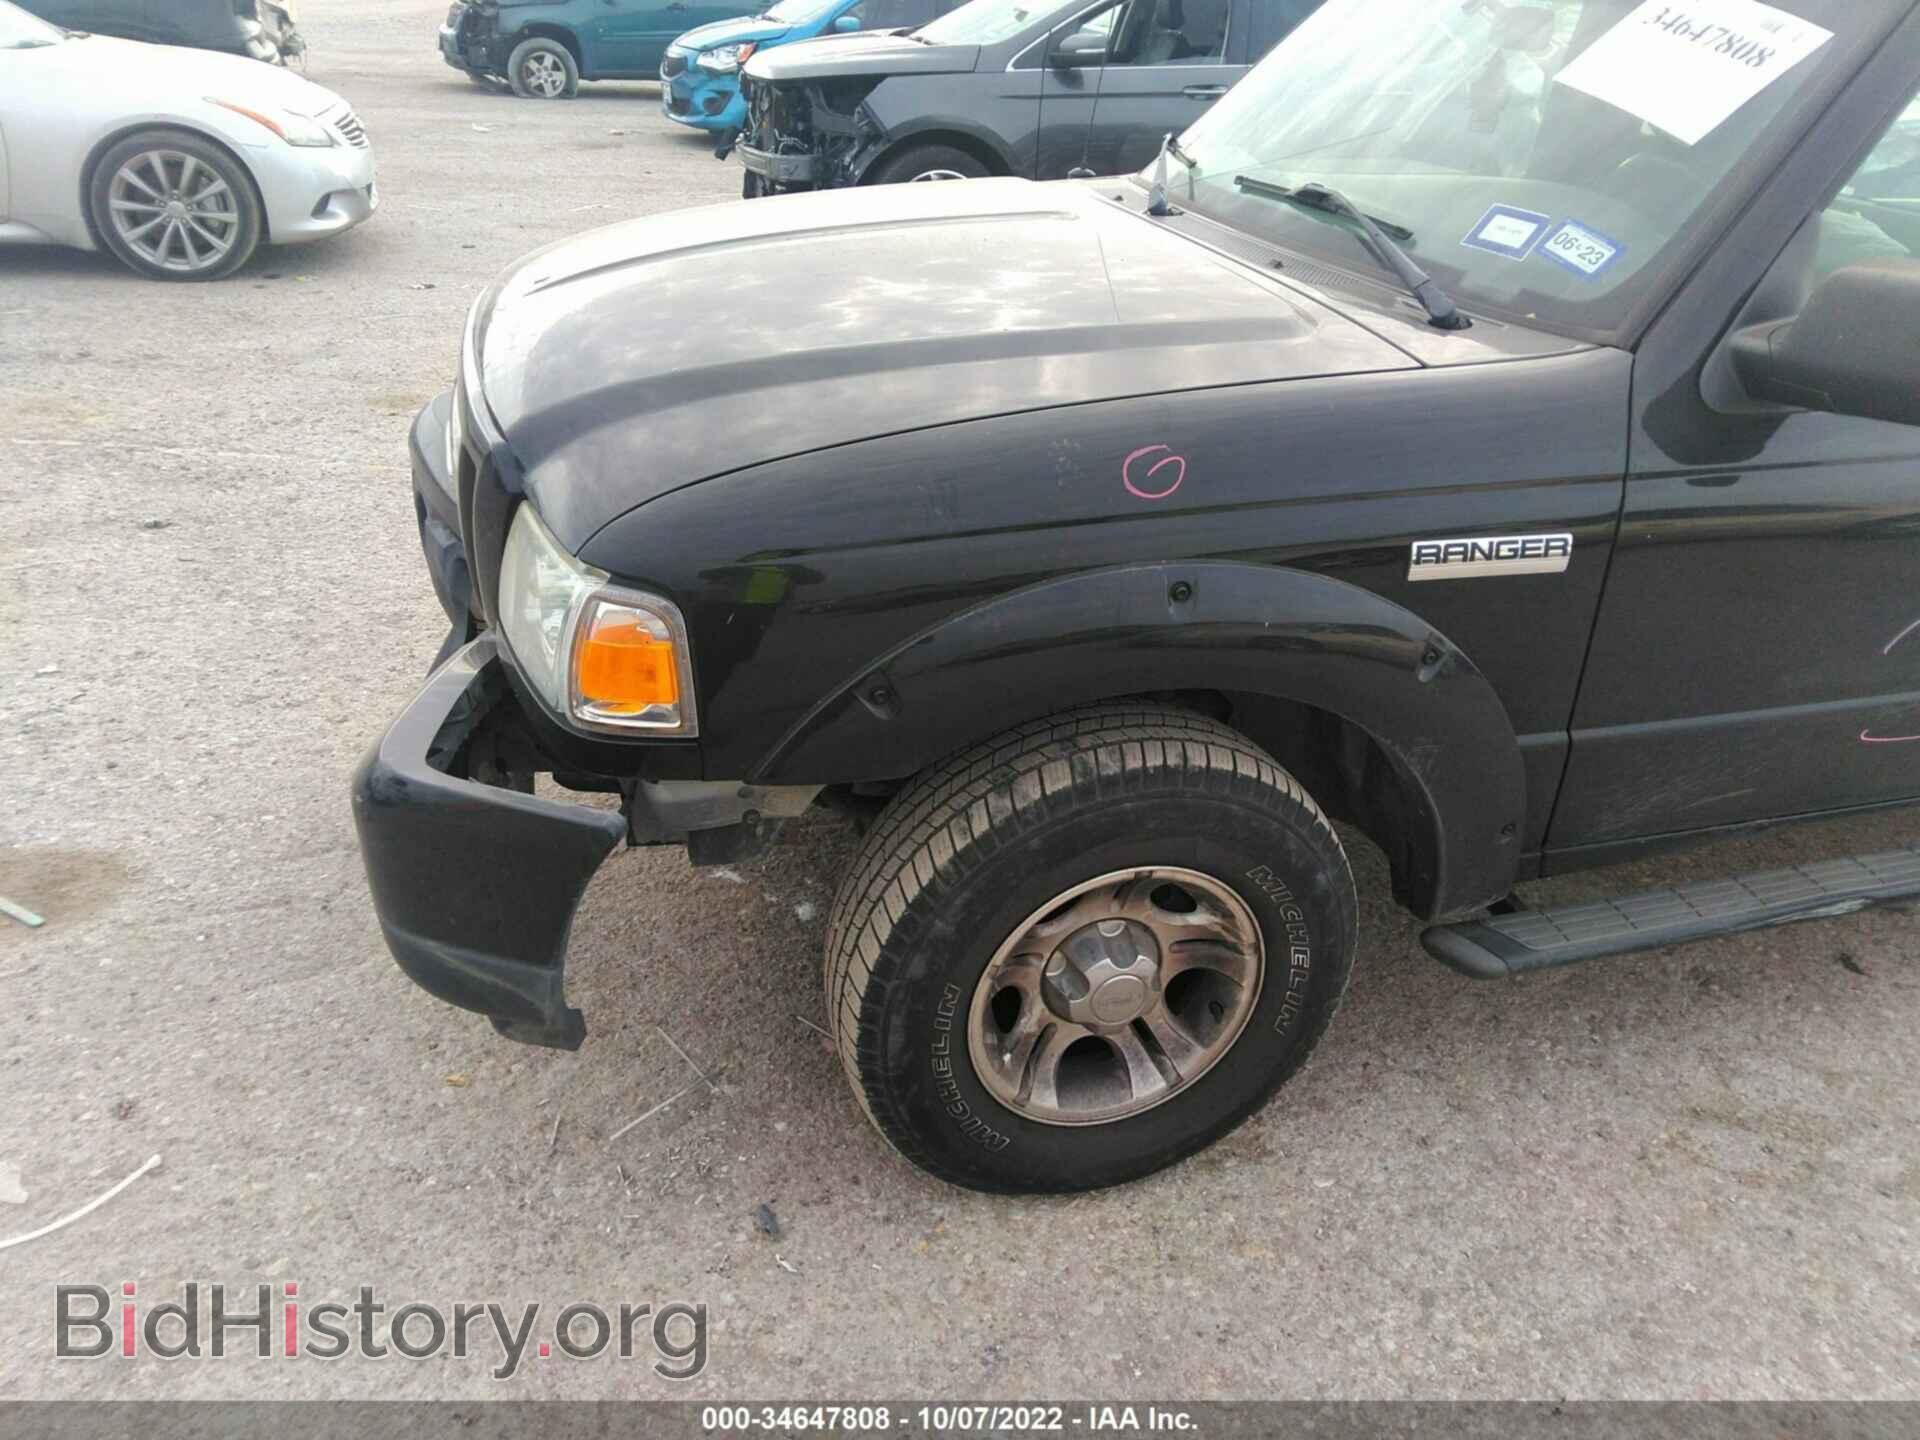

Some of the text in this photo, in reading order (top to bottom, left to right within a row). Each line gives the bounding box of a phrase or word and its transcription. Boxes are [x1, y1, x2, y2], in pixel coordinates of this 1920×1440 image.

[1642, 7, 1776, 68] 34647808
[1412, 536, 1571, 566] RANGER
[1245, 864, 1311, 1036] MICHELIN
[930, 983, 1011, 1153] MICHELIN
